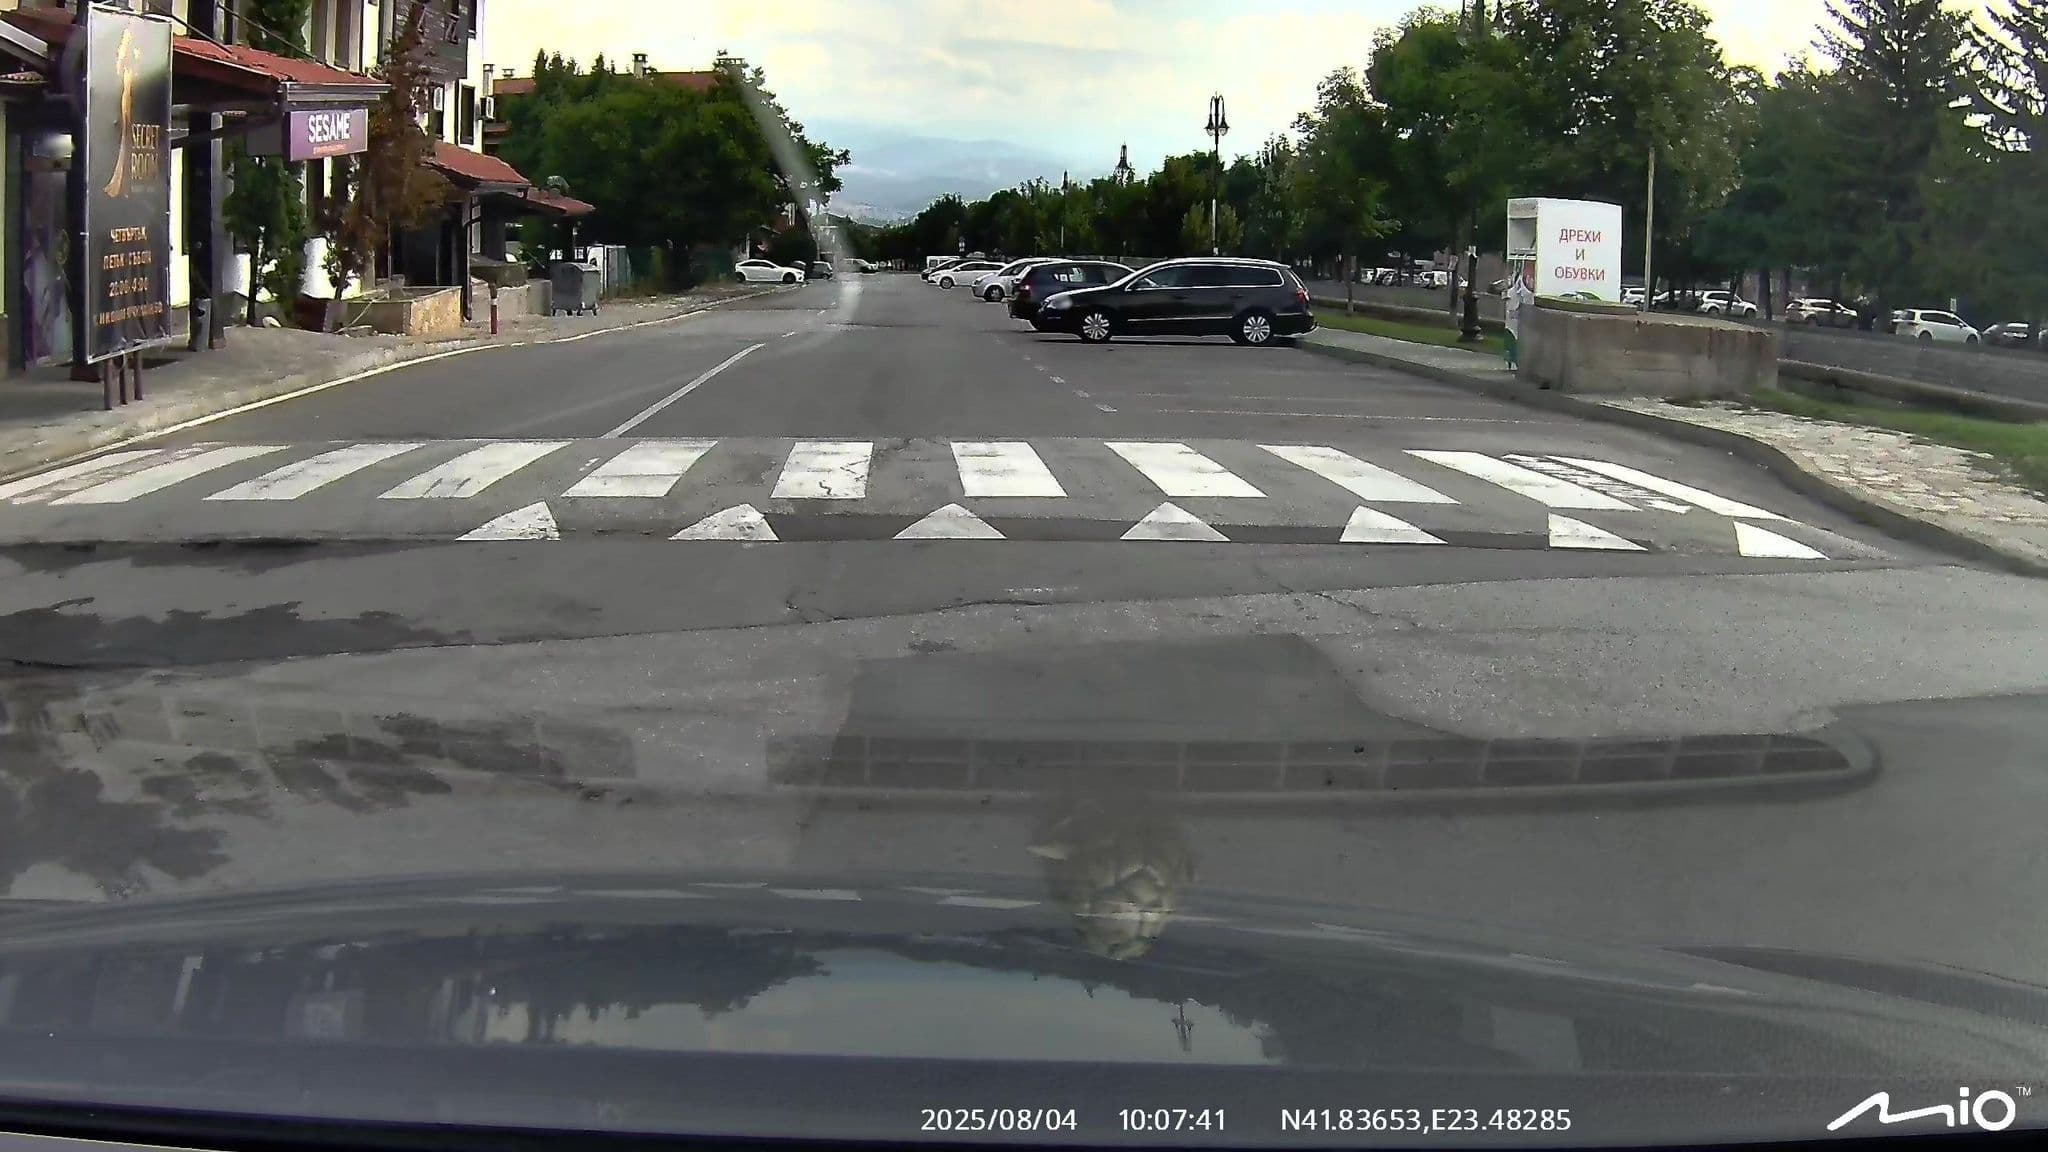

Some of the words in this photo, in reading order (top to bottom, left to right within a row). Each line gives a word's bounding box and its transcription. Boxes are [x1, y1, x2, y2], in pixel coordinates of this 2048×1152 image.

[131, 123, 160, 150] SECRET
[308, 112, 351, 143] SESAME
[131, 152, 160, 180] ROOM
[1559, 228, 1601, 244] ДРЕХИ
[1575, 248, 1585, 261] И
[1554, 266, 1605, 281] ОБУВКИ
